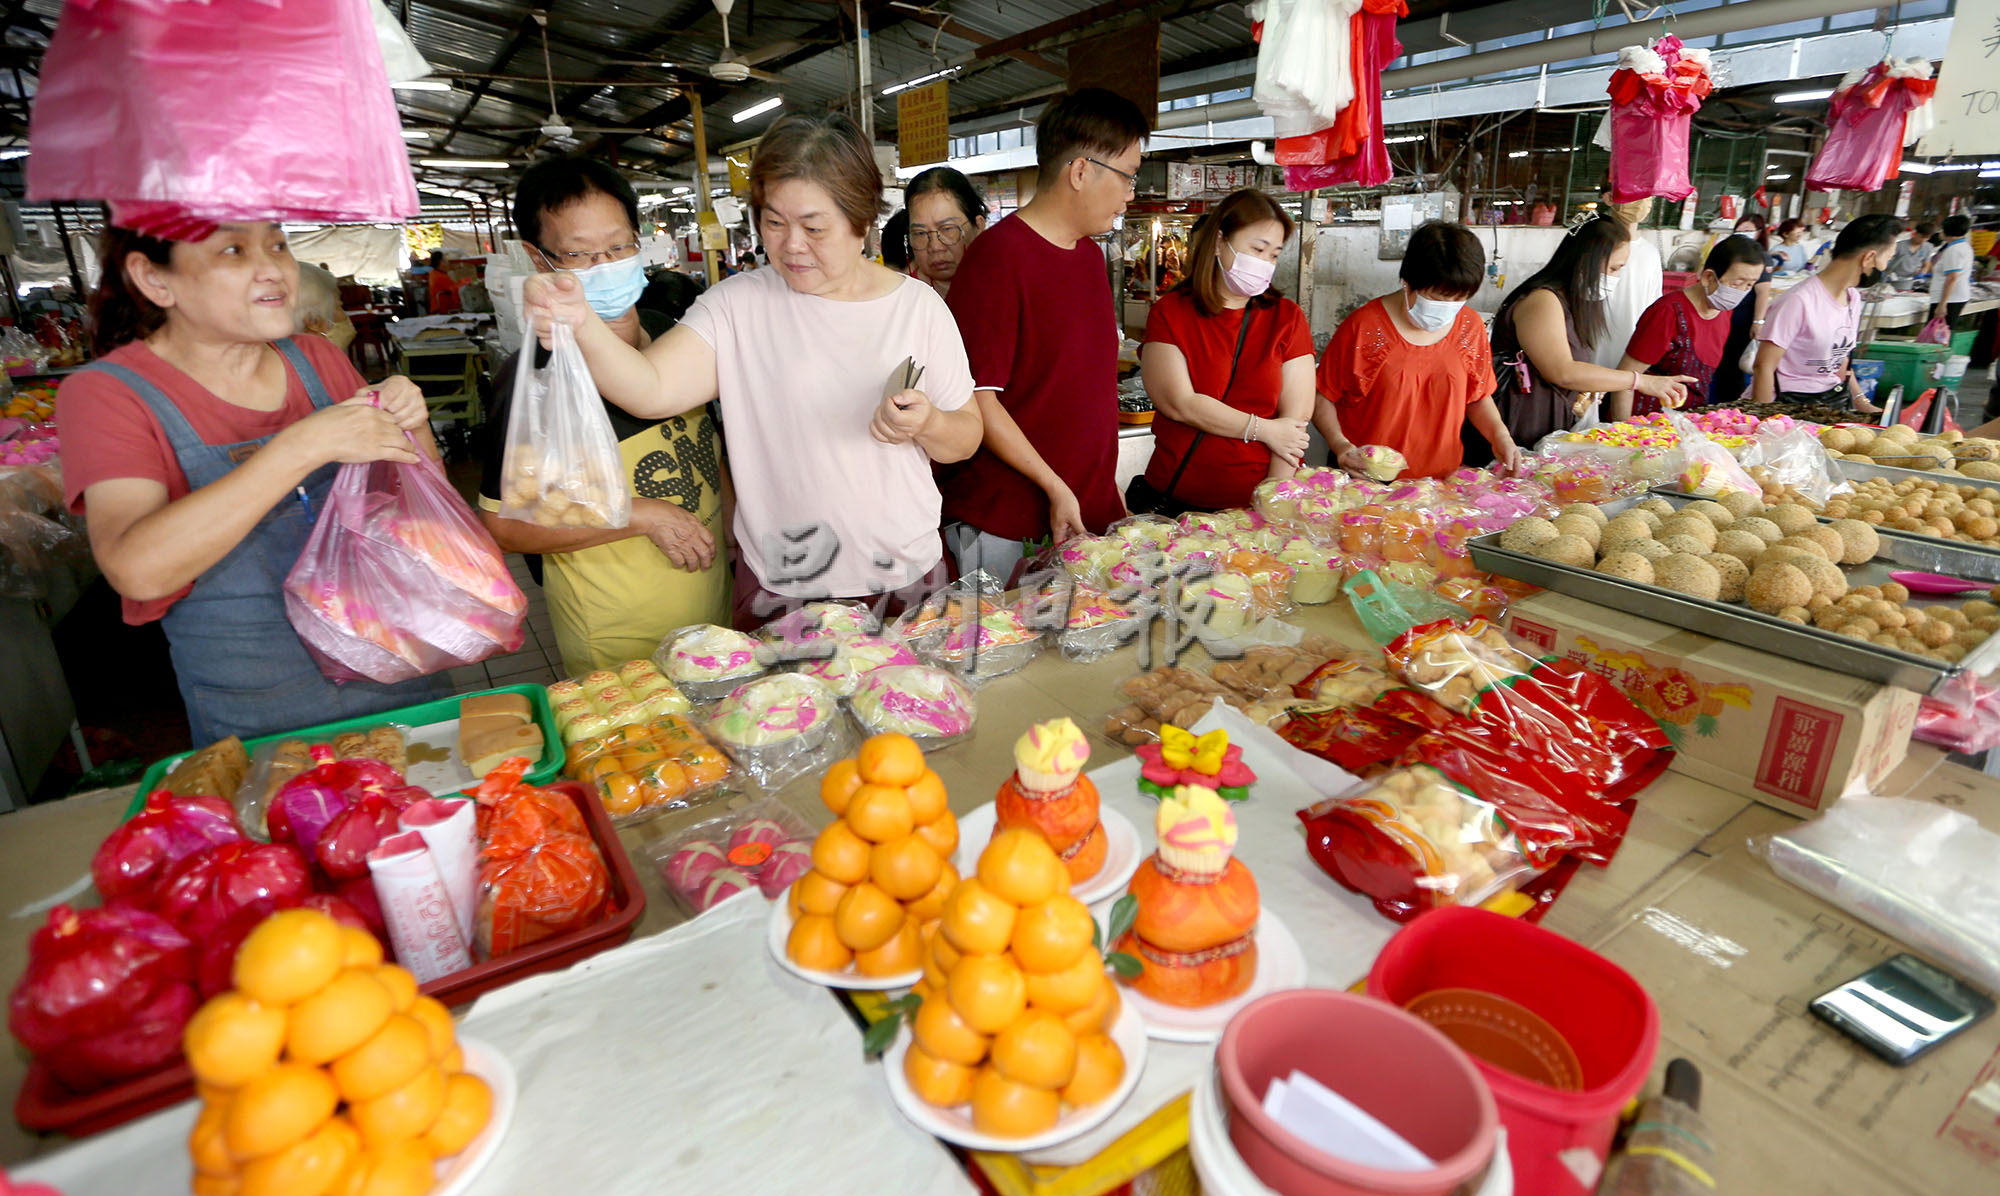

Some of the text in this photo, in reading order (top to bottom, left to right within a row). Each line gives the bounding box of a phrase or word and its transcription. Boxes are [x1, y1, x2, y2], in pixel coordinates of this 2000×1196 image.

[1961, 89, 2000, 116] TO
[1777, 713, 1820, 793] 財源廣進
